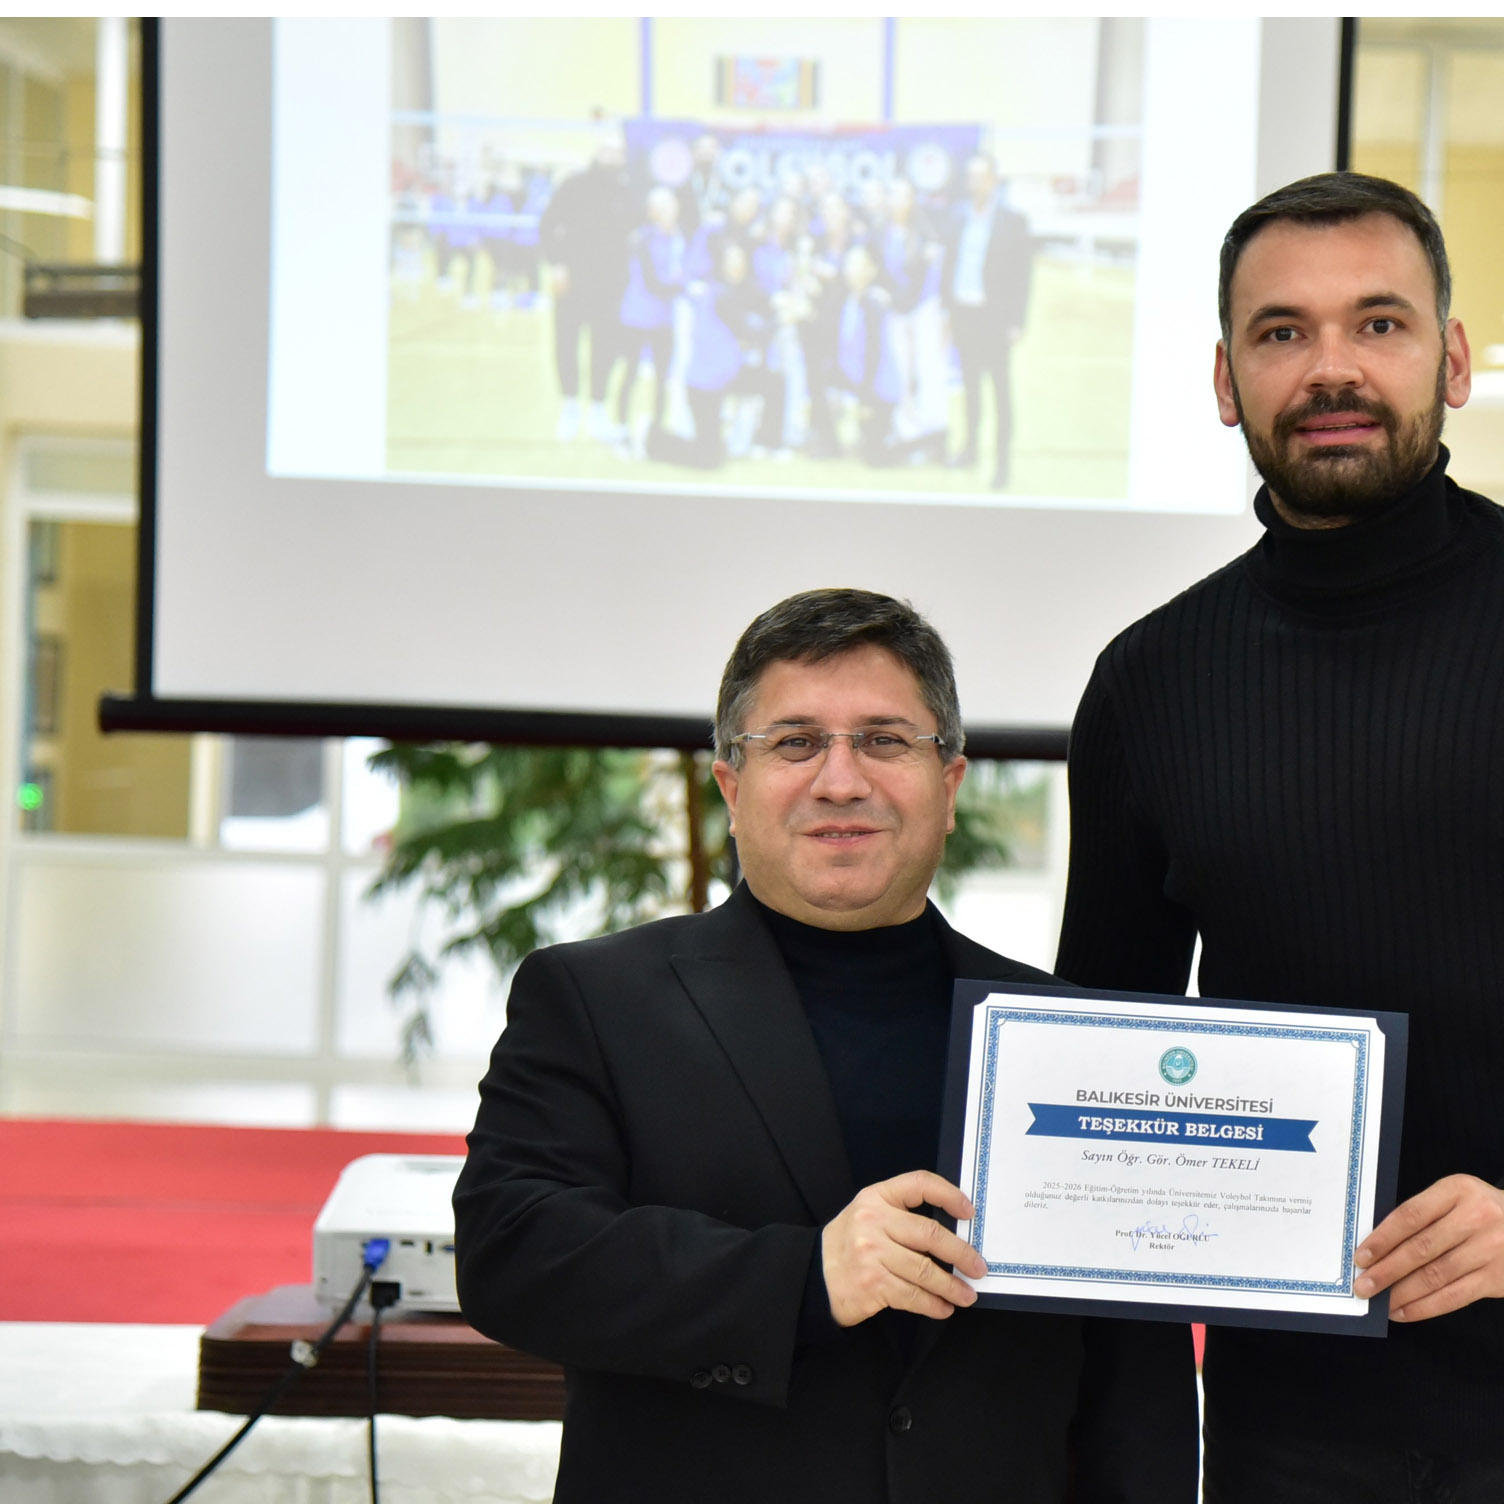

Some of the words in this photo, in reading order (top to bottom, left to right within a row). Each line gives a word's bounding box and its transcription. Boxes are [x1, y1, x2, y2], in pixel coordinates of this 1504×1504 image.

[1076, 1089, 1160, 1107] BALIKESİR
[1164, 1092, 1274, 1113] ÜNİVERSİTESİ
[1078, 1115, 1180, 1136] TEŞEKKÜR
[1185, 1123, 1264, 1141] BELGESİ
[1081, 1149, 1113, 1165] Sayın
[1117, 1149, 1142, 1167] Öğr.
[1146, 1153, 1171, 1166] Gör.
[1175, 1153, 1208, 1169] Ömer
[1211, 1157, 1261, 1171] TEKELİ
[1024, 1201, 1049, 1210] dileriz.
[1025, 1191, 1062, 1201] olduğunuz
[1064, 1193, 1089, 1202] değerli
[1146, 1197, 1168, 1207] dolayı
[1171, 1199, 1200, 1209] teşekkür
[1203, 1201, 1221, 1210] eder,
[1223, 1202, 1279, 1214] çalışmalarınızda
[1282, 1205, 1312, 1215] başarılar
[1141, 1187, 1166, 1197] yılında
[1169, 1188, 1217, 1199] Üniversitemiz
[1220, 1192, 1251, 1202] Voleybol
[1255, 1194, 1287, 1203] Takımına
[1289, 1197, 1312, 1206] vermiş
[1115, 1229, 1133, 1238] Prof.
[1135, 1231, 1148, 1239] Dr.
[1150, 1231, 1171, 1240] Yücel
[1149, 1242, 1175, 1251] Rektör
